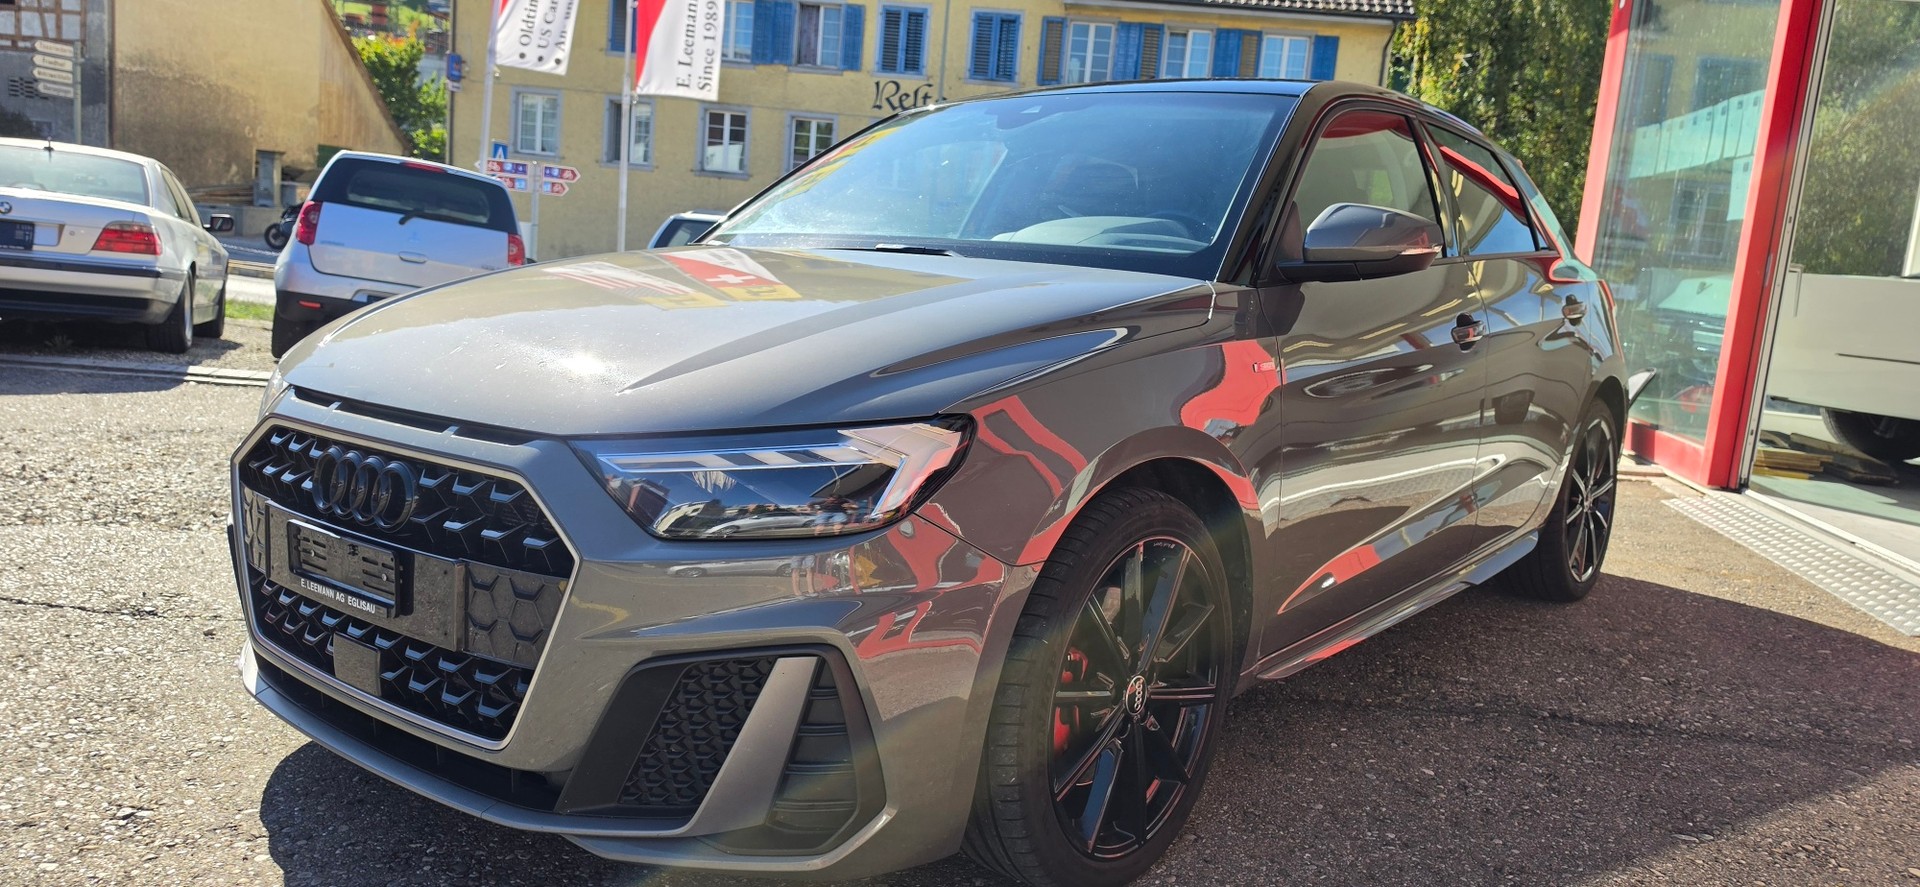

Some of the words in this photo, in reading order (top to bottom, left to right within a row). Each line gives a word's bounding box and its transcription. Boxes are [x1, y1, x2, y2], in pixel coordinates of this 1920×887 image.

[537, 28, 553, 49] US
[703, 0, 719, 41] 1989
[676, 74, 692, 89] E.
[698, 48, 716, 93] Since
[300, 578, 307, 588] E.
[306, 580, 335, 599] LEEMANN
[335, 591, 345, 603] AG
[347, 595, 376, 614] EGLISAU
